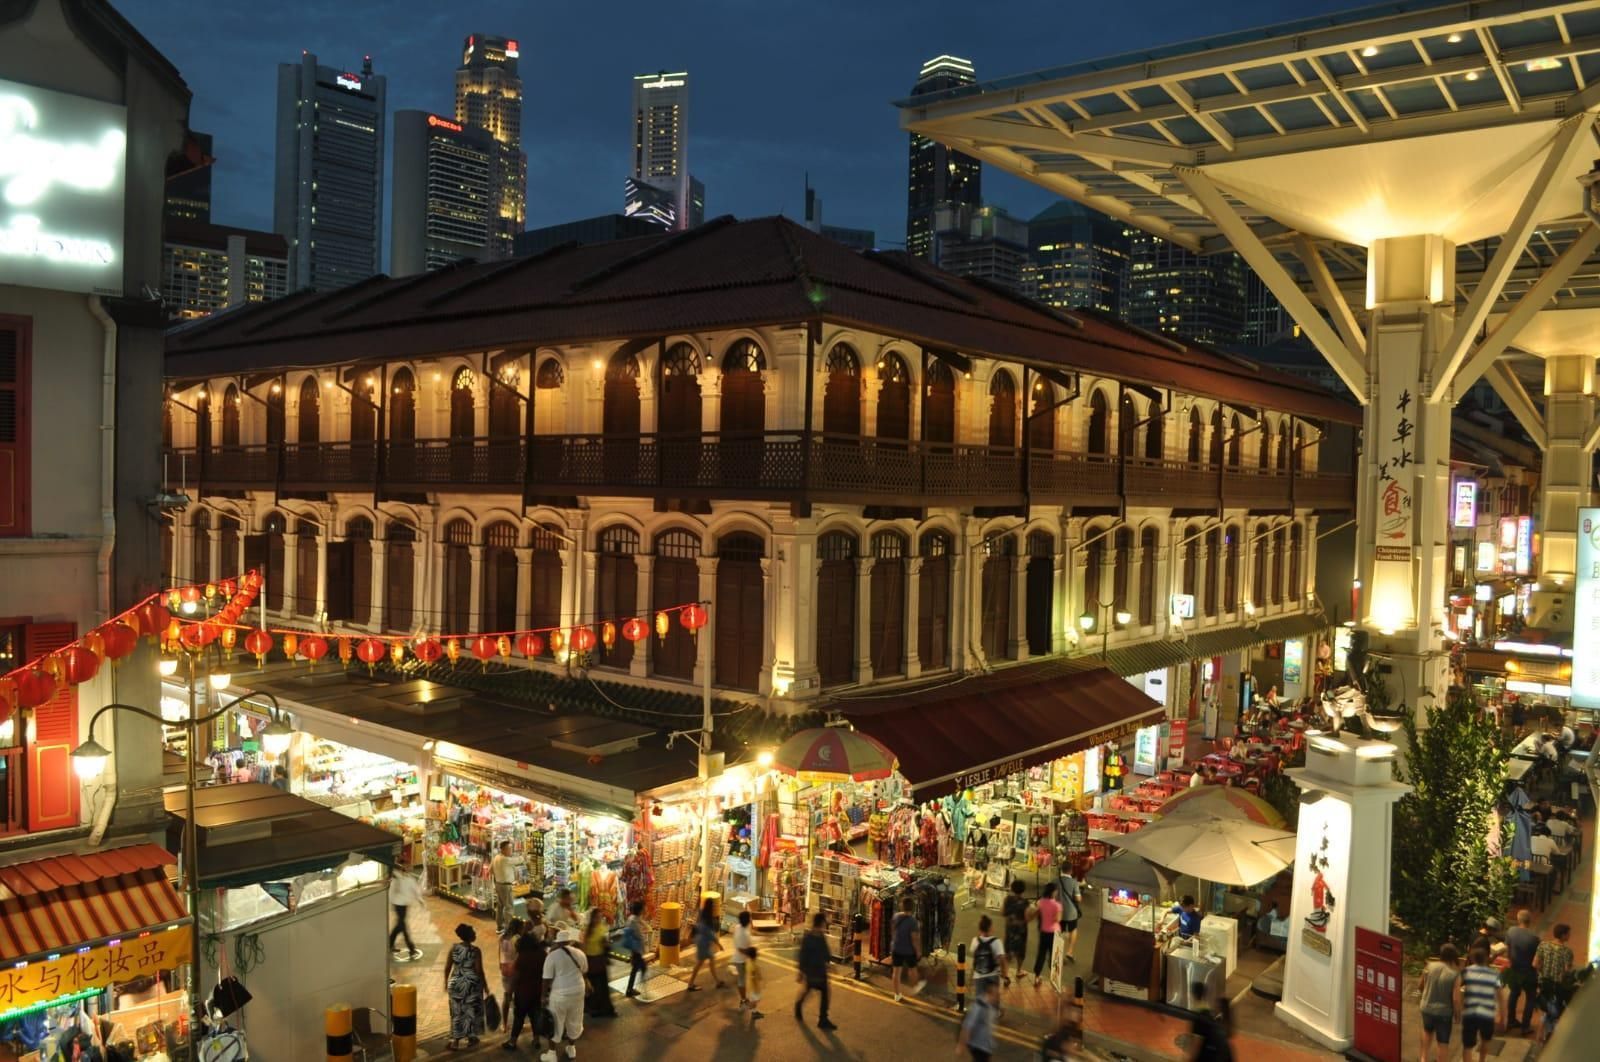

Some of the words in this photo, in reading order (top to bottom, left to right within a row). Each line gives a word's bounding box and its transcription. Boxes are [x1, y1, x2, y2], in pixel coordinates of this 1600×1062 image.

[1089, 727, 1119, 745] Wholesale
[1120, 724, 1126, 736] &
[965, 769, 991, 787] LESLIE
[0, 940, 166, 1003] 水与化妆品
